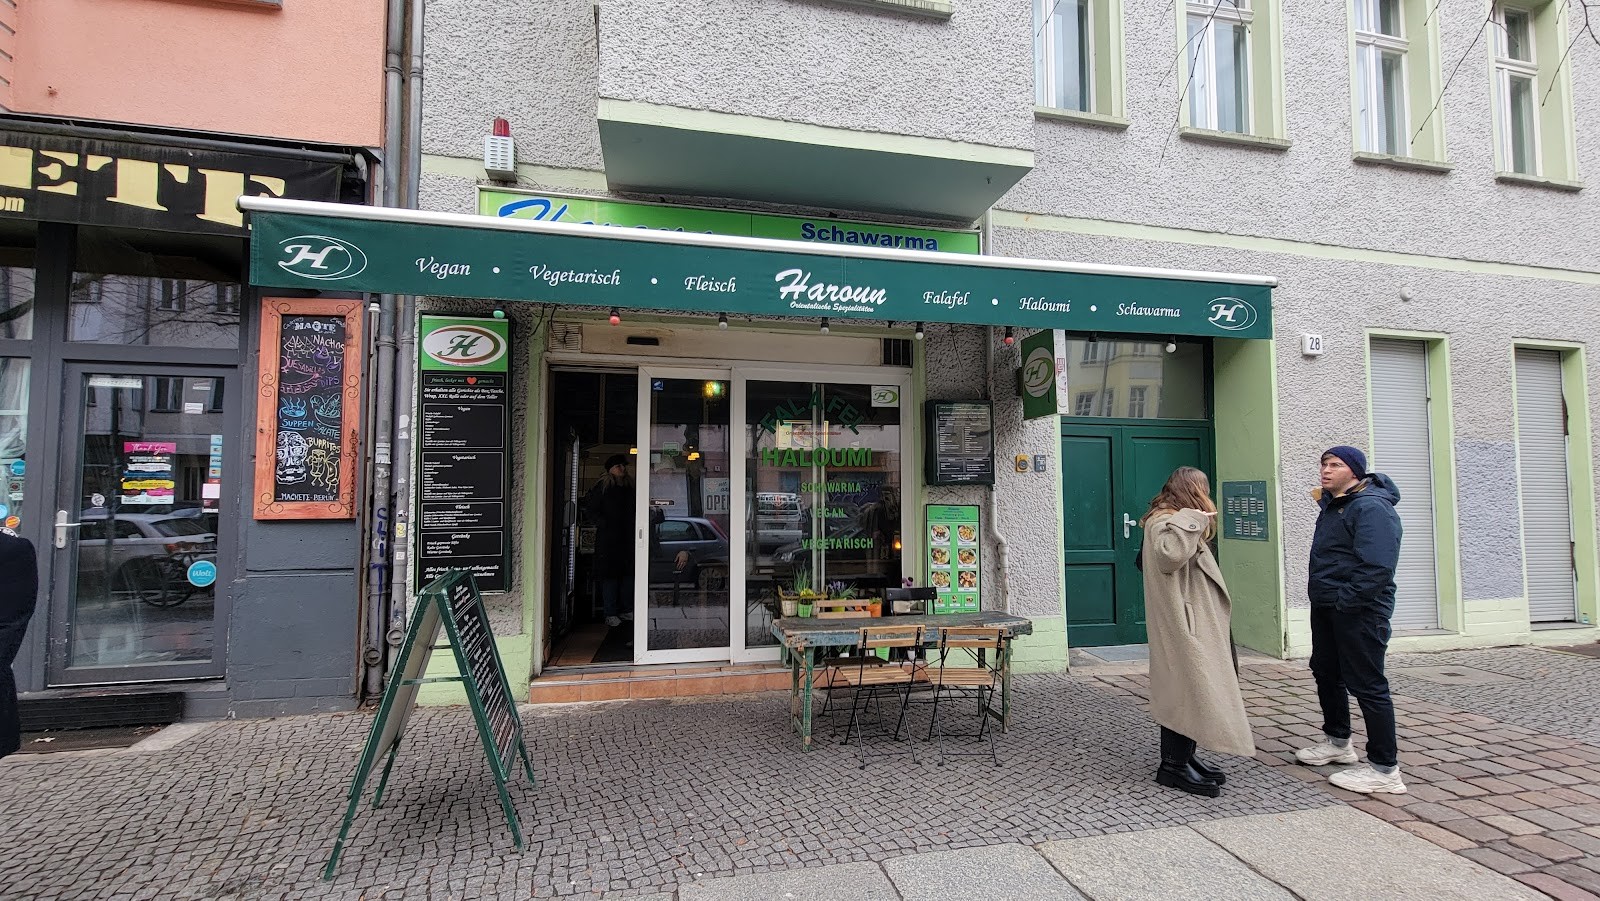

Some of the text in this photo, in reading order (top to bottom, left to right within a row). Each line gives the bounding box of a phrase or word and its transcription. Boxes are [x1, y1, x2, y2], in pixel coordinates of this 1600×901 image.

[800, 222, 938, 251] Schawarma
[415, 256, 737, 293] Vegan Vegetarisch Fleisch
[775, 268, 887, 305] Haroun
[790, 300, 875, 313] Orientalische Spezialitäten
[923, 290, 1180, 318] Falafel Haloumi Schawarma
[313, 335, 345, 353] NACHOS
[1309, 337, 1320, 350] 28
[760, 390, 865, 435] FALAFEL
[314, 423, 341, 439] SALATE
[762, 447, 873, 467] HALOUMI
[801, 482, 861, 493] SCHAWARMA
[706, 495, 729, 510] OPE
[809, 507, 845, 518] VEGAN
[801, 537, 874, 550] VEGETARISCH
[192, 569, 212, 577] Wolt
